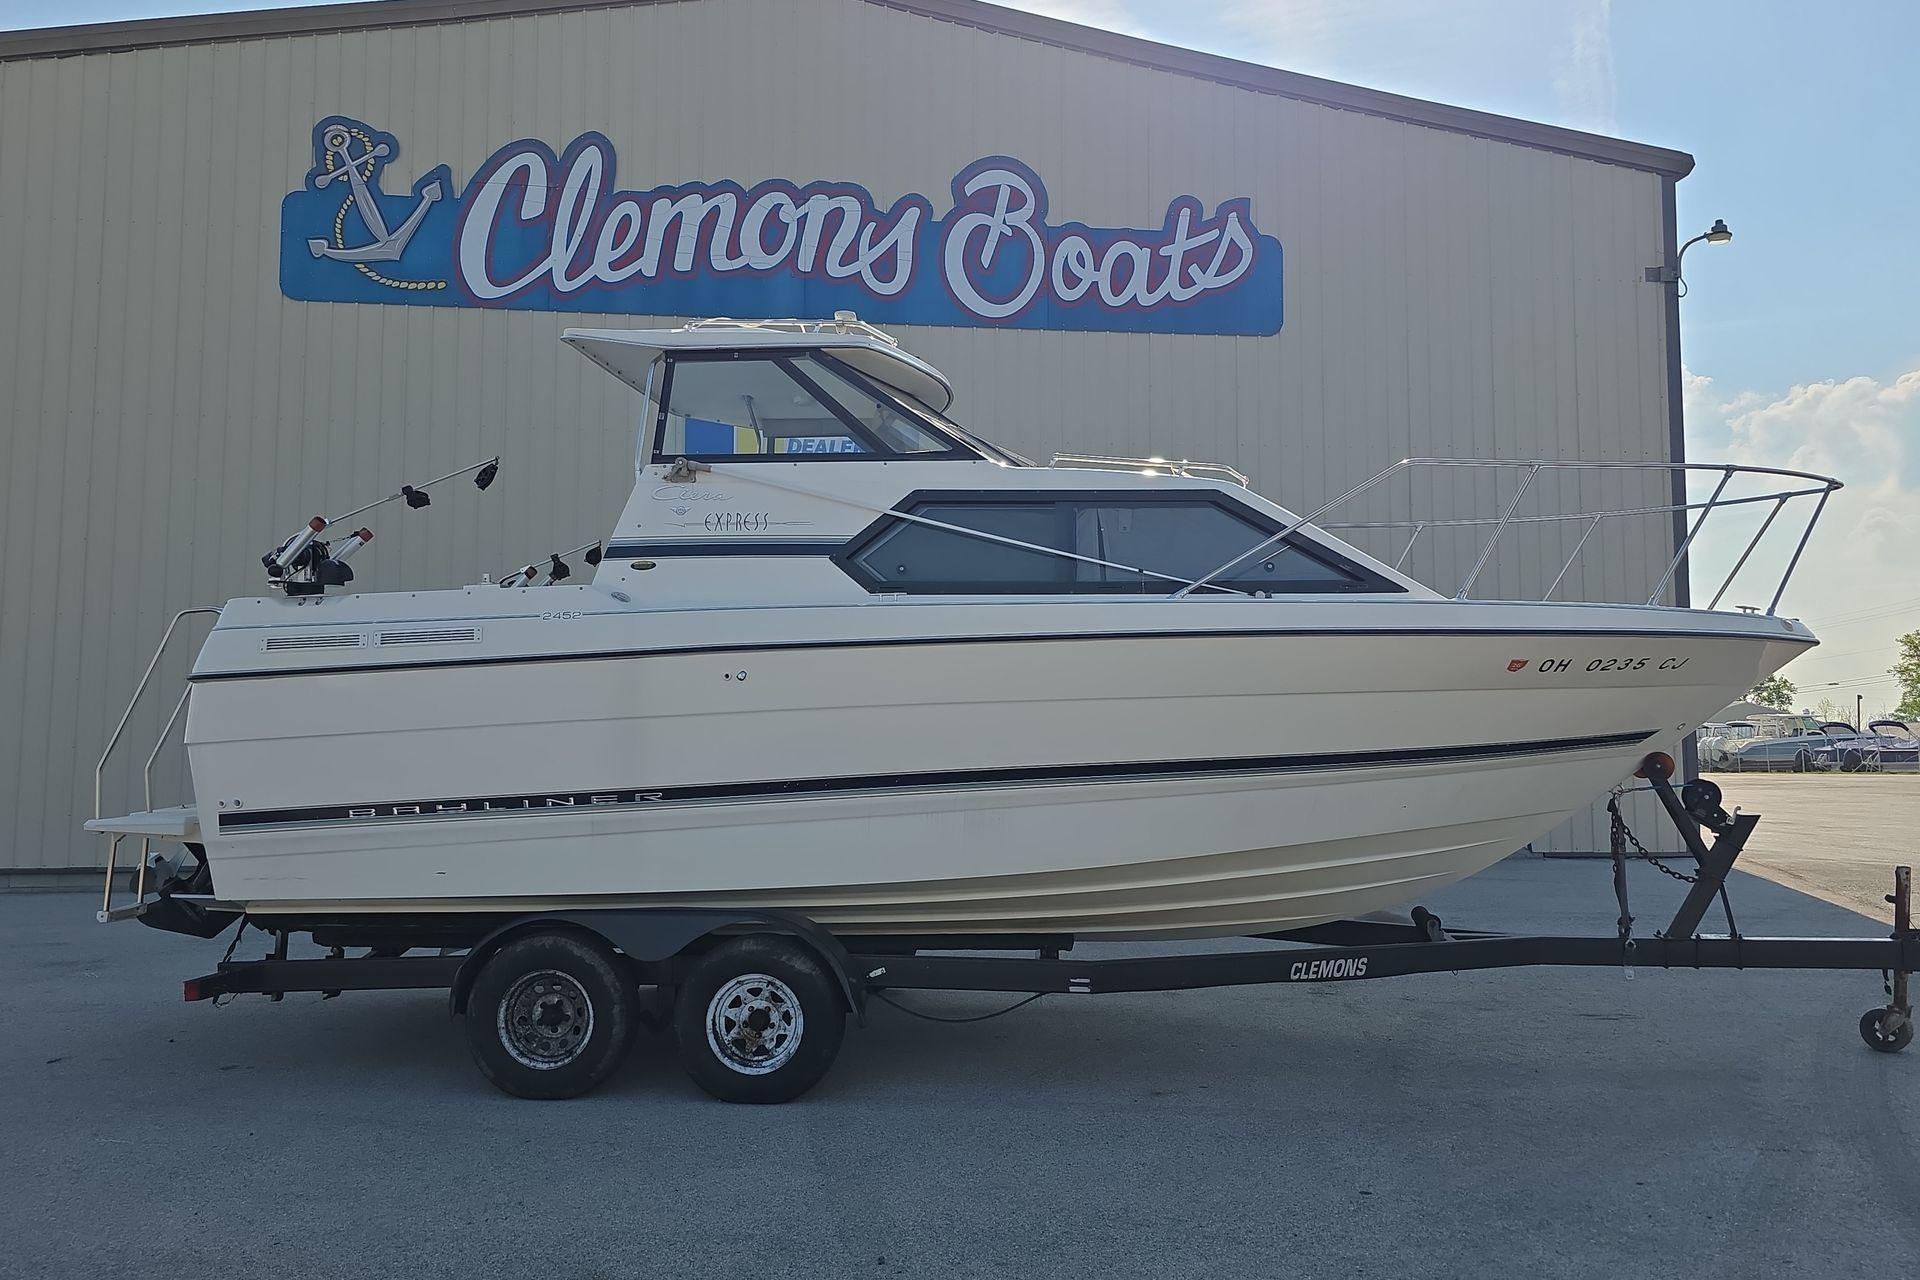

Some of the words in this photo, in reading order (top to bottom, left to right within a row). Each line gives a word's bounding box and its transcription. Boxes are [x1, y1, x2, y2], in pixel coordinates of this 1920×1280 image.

[459, 144, 919, 299] Clemons
[944, 168, 1254, 318] Boats
[704, 512, 769, 531] EXPRESS
[542, 611, 582, 620] 2452
[1538, 658, 1573, 673] OH
[1585, 657, 1651, 672] 0235
[1658, 657, 1690, 670] CJ
[348, 792, 662, 818] BAYLINER
[1289, 957, 1368, 980] CLEMONS
